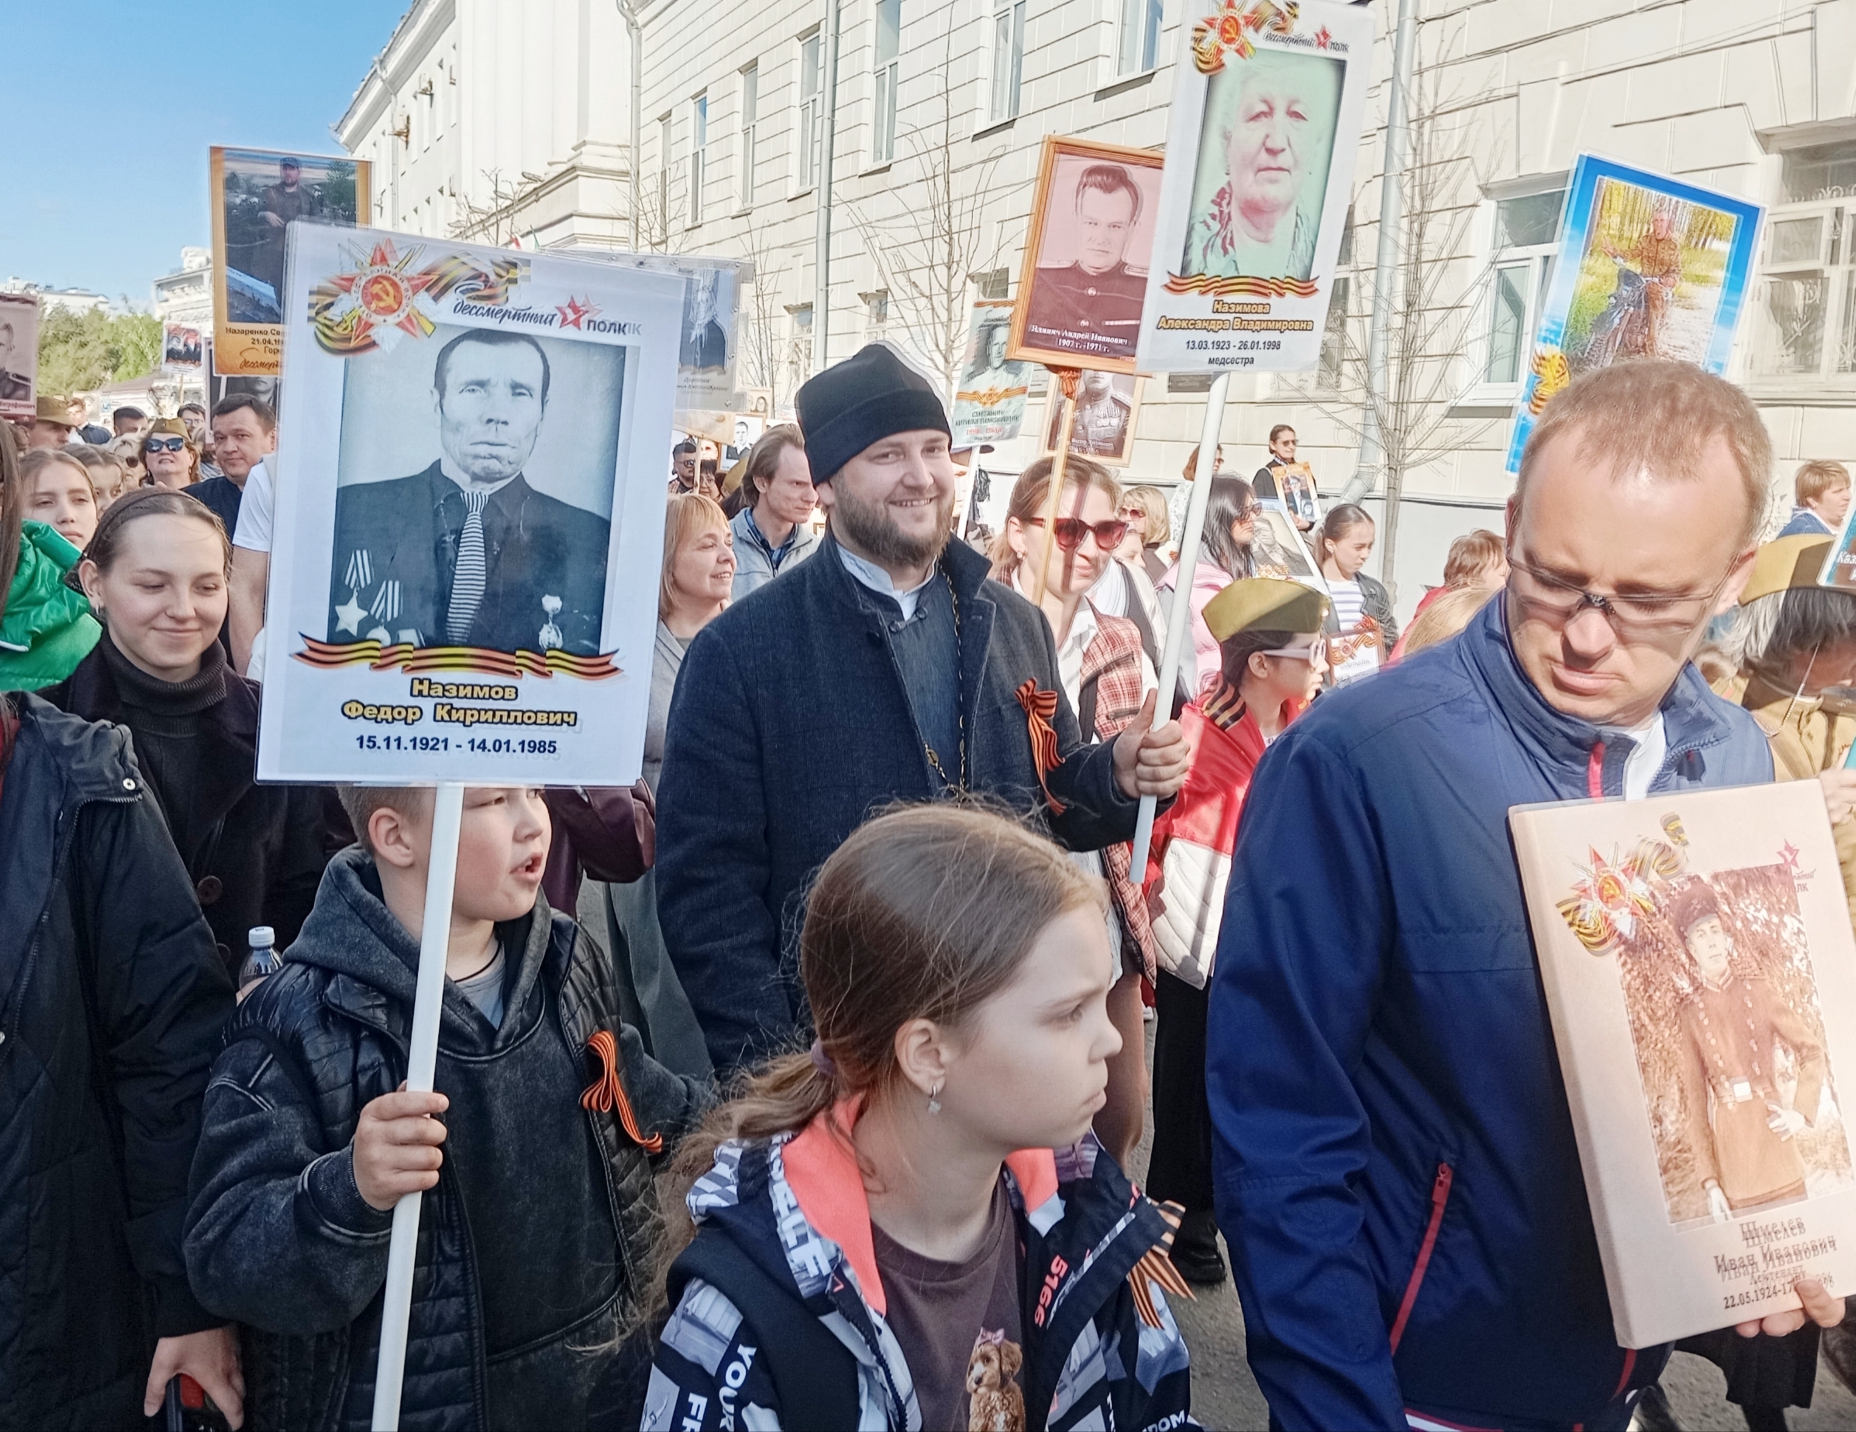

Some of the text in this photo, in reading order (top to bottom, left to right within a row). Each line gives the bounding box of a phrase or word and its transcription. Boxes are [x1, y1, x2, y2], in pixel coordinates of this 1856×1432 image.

[1212, 300, 1271, 315] Назимова
[1156, 316, 1314, 333] Александра Владимировна
[1185, 339, 1231, 351] 13.03.1923
[1238, 340, 1282, 351] 26.01.1998
[1207, 356, 1254, 367] медсестра
[410, 678, 518, 701] Назимов
[341, 700, 577, 727] Федор Кириллович
[356, 734, 449, 751] 15.11.1921
[467, 737, 558, 754] 14.01.1985
[1740, 1217, 1806, 1249] Шмелев
[1714, 1235, 1838, 1282] Иван Иванович
[718, 1343, 757, 1432] YOUR
